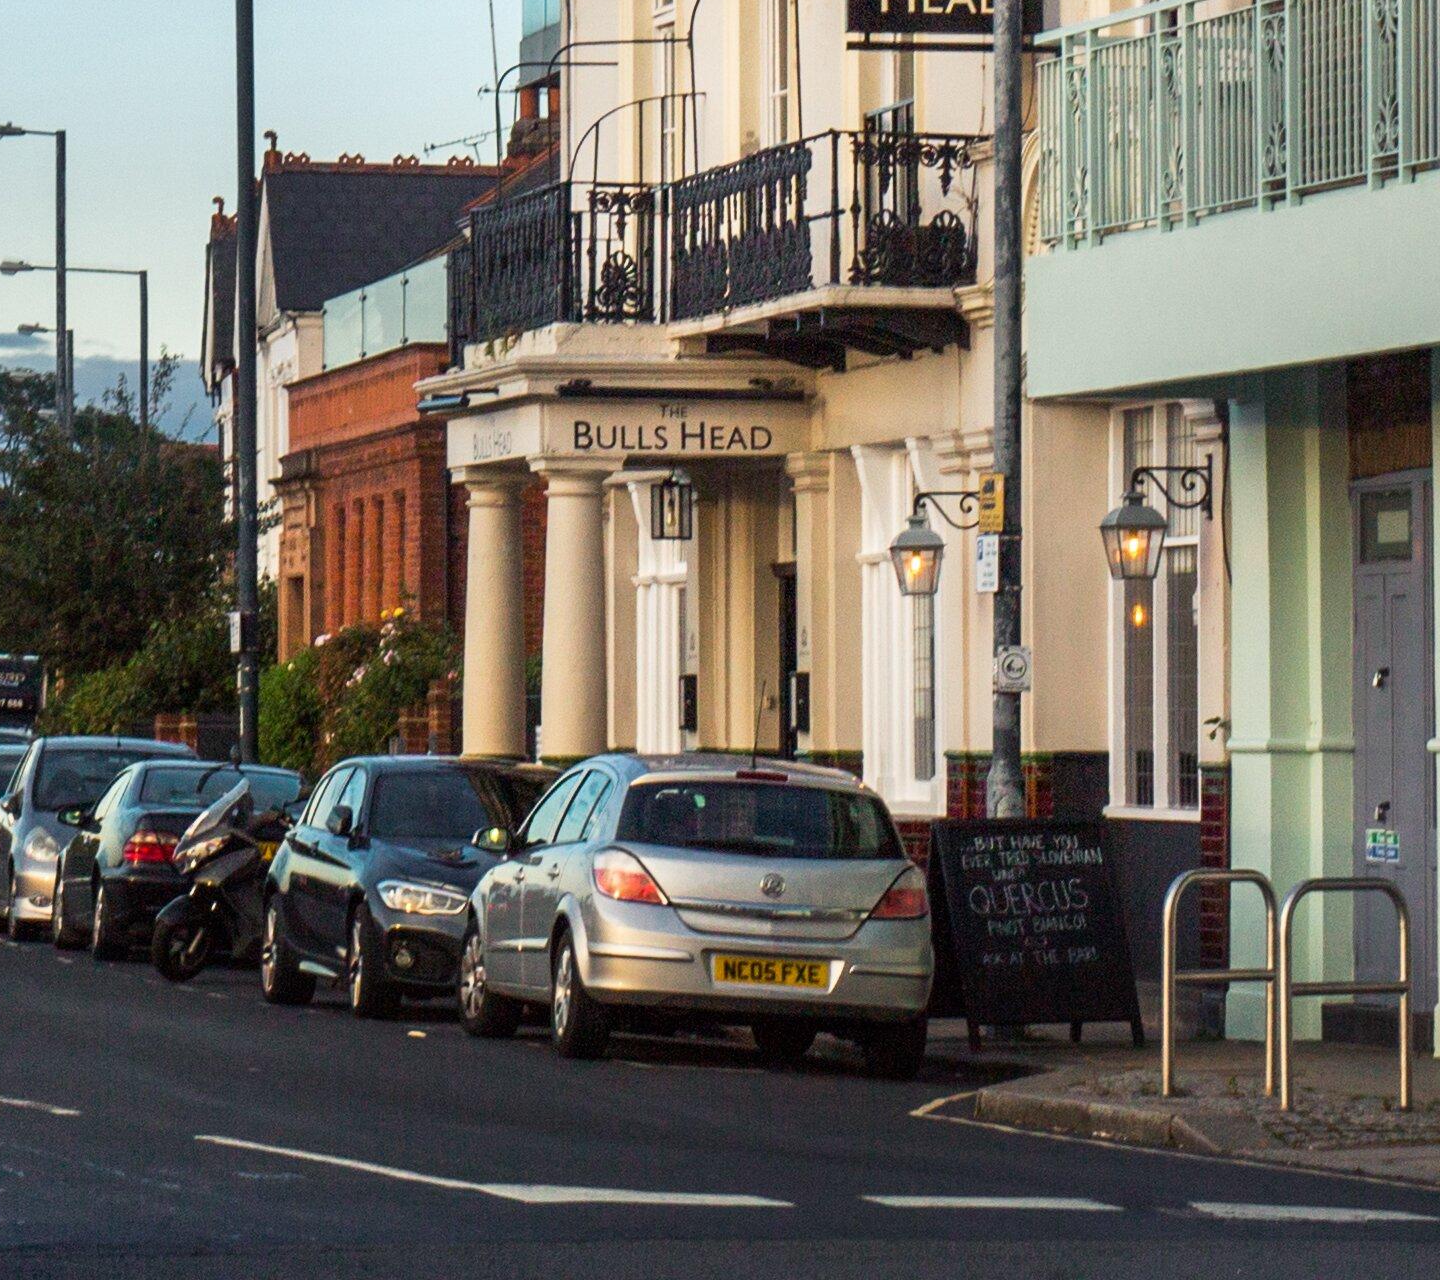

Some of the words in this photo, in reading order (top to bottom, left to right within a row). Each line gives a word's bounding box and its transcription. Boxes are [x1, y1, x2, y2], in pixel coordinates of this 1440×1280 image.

[660, 404, 688, 418] THE
[573, 420, 668, 451] BULLS
[681, 421, 773, 452] HEAD
[1053, 834, 1079, 850] YOU
[969, 877, 1089, 915] QUERCUS
